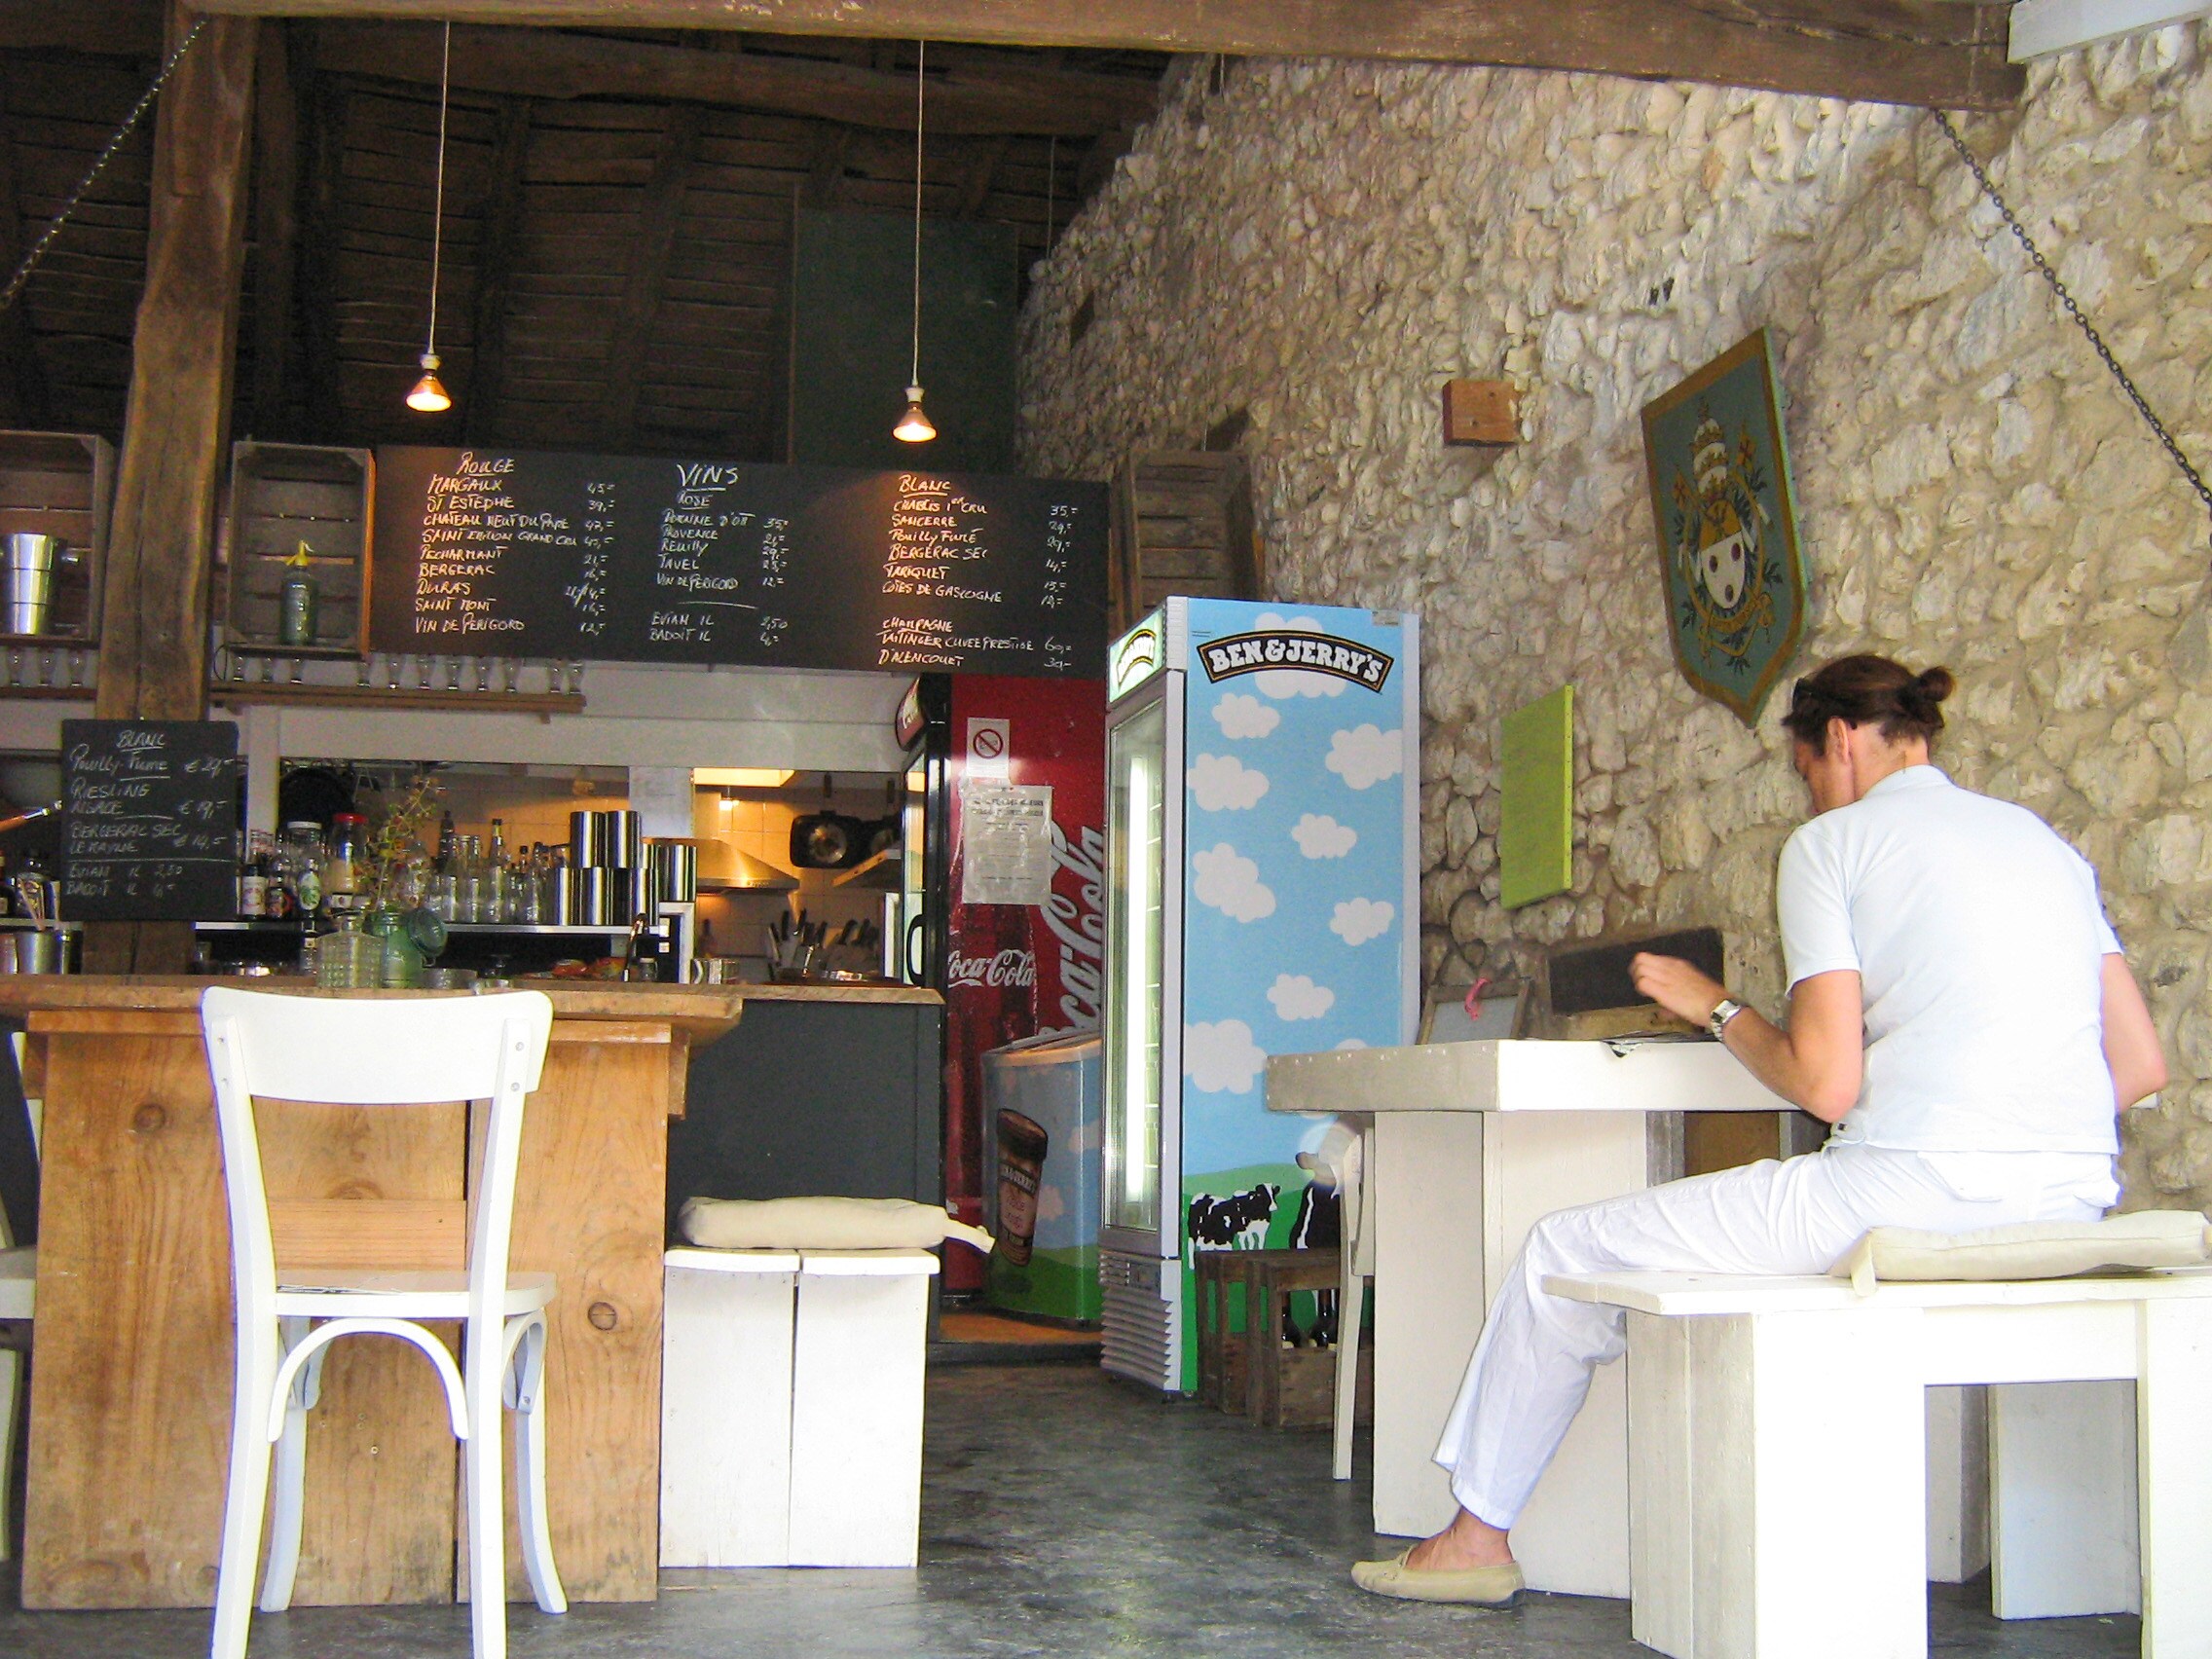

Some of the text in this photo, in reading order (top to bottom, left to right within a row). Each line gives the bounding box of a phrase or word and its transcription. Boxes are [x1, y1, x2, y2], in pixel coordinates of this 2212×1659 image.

[427, 473, 503, 495] MARGAUX
[900, 474, 951, 493] BLANC
[894, 498, 941, 512] CHABLIS
[961, 501, 988, 515] CRU
[424, 511, 482, 527] CHATEAU
[892, 513, 958, 528] SANCERRE
[658, 552, 700, 571] TAVEL
[888, 542, 960, 562] BERGERAC
[420, 562, 496, 578] BERGERAC
[417, 577, 471, 596] DURAS
[1208, 638, 1384, 683] BEN & JERRY'S
